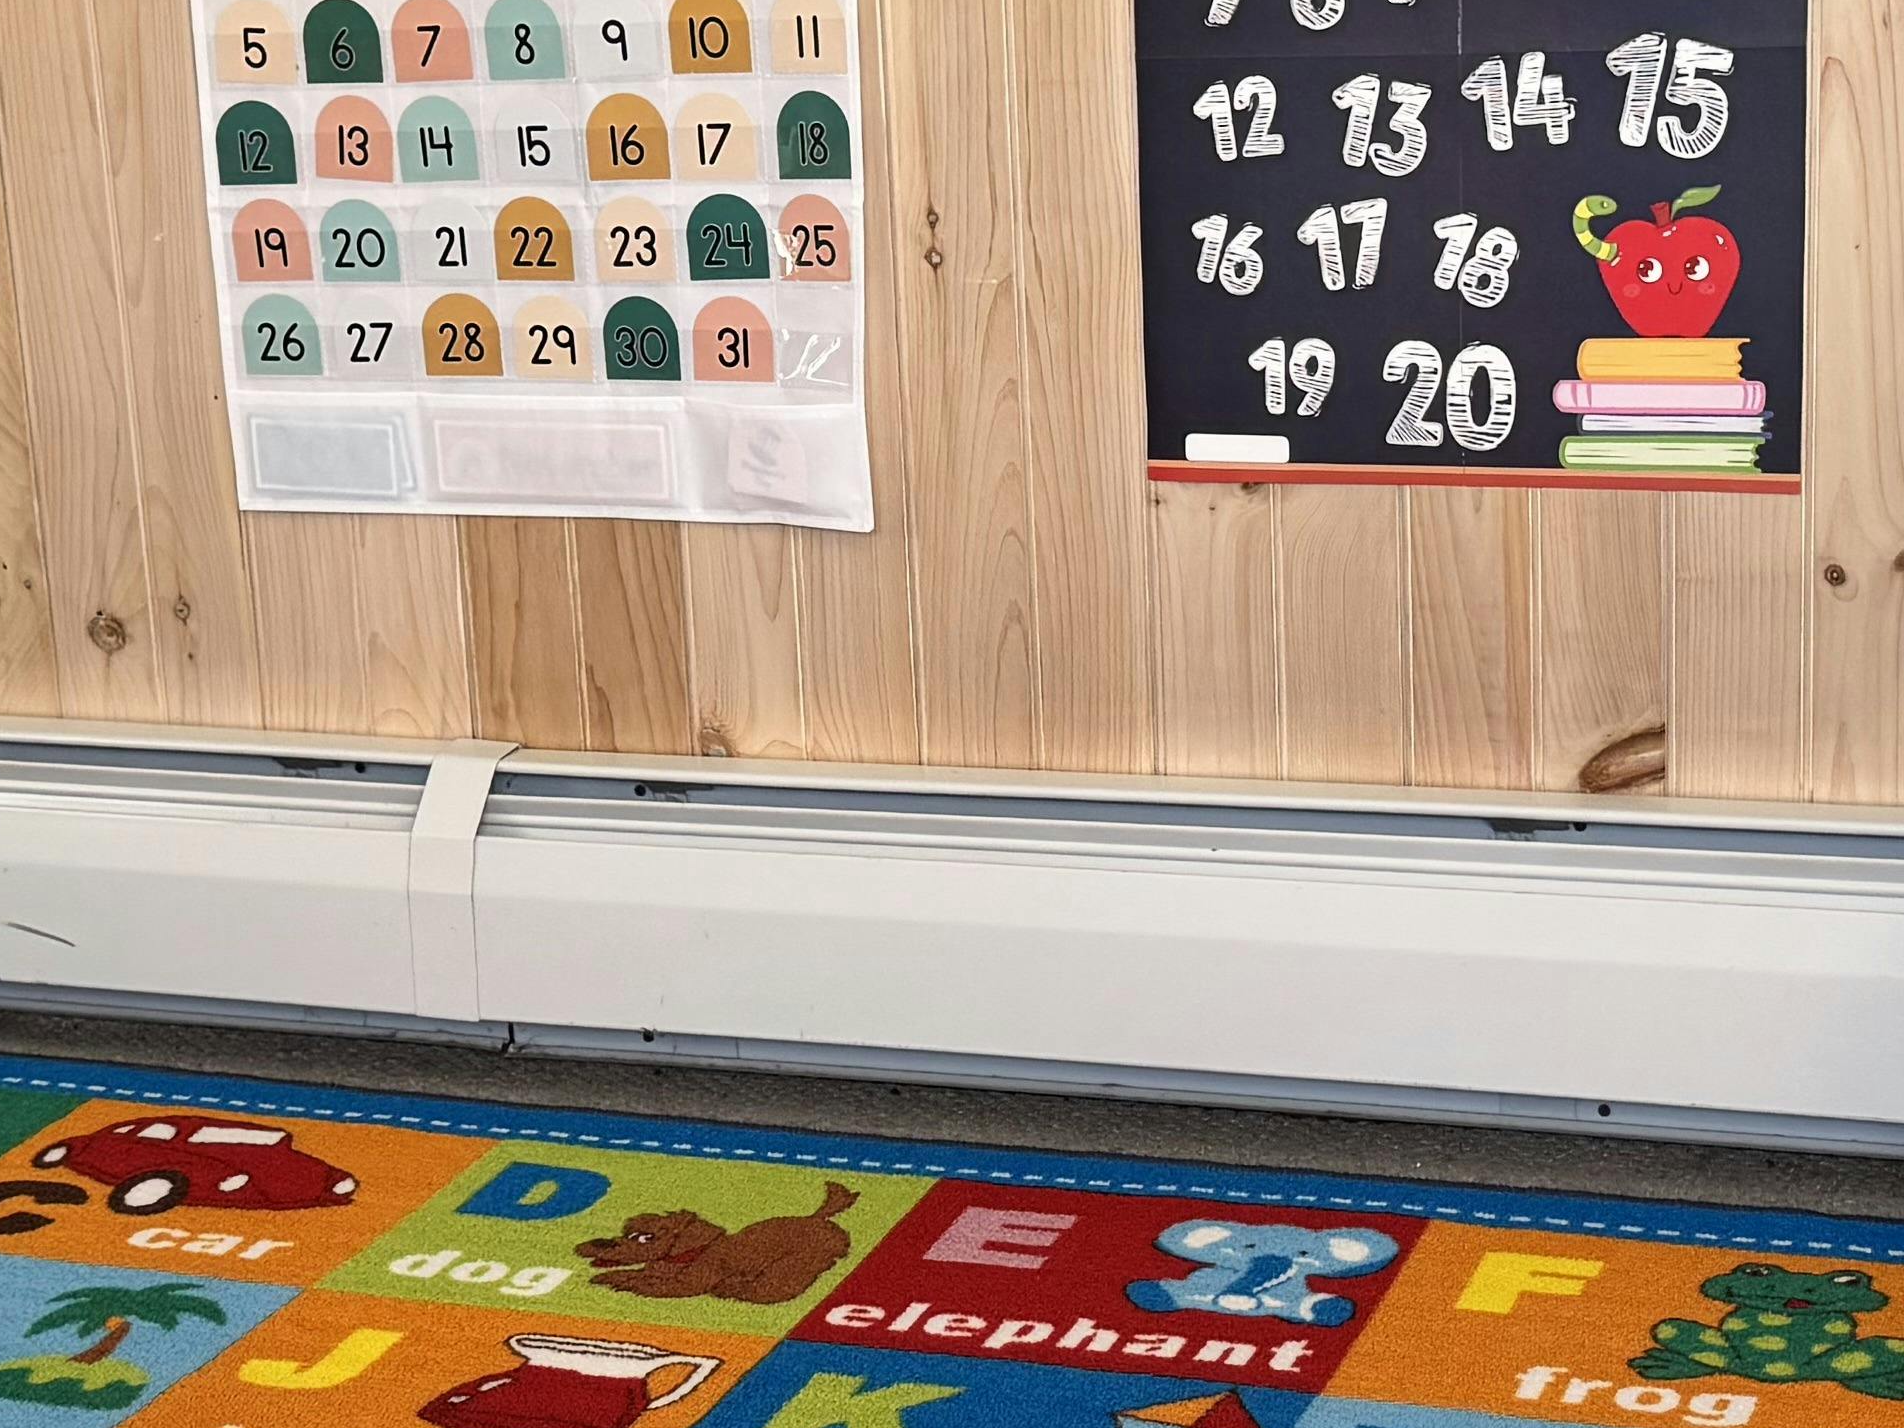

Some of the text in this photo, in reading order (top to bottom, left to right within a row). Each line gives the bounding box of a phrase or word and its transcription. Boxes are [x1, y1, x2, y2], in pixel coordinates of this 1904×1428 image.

[243, 15, 821, 70] 5 6 7 8 9 10 11
[1193, 32, 1734, 176] 12 13 14 15
[239, 124, 829, 172] 12 13 14 15 16 17 18
[254, 224, 836, 268] 19 20 21 22 23 24 25
[1192, 198, 1518, 309] 16 17 18
[258, 322, 748, 368] 26 27 28 29 30 31
[1248, 337, 1516, 451] 19 20
[453, 1161, 611, 1220] D
[126, 1223, 296, 1262] car
[921, 1206, 1076, 1271] E
[389, 1248, 573, 1298] dog
[1455, 1251, 1606, 1315] F
[237, 1327, 404, 1394] J
[823, 1296, 1312, 1375] elephant
[1513, 1365, 1760, 1428] frog
